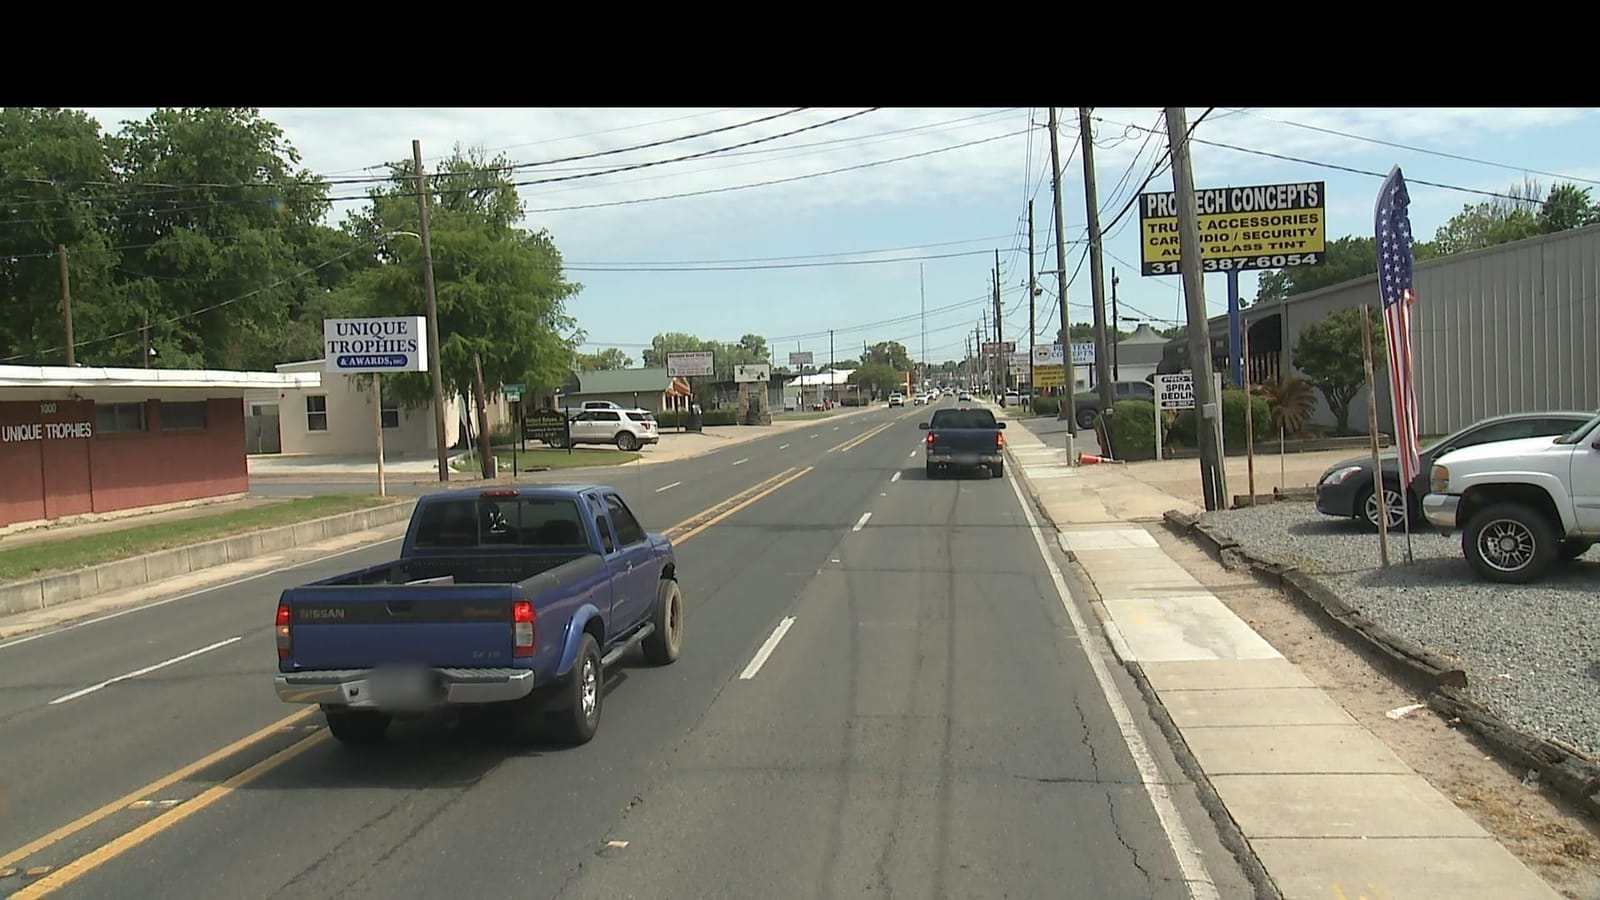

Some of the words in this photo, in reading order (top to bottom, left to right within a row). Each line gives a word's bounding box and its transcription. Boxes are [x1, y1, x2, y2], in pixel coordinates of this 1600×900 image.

[1194, 189, 1226, 215] ECH
[1231, 183, 1318, 211] CONCEPTS
[1207, 213, 1319, 230] ACCESSORIES
[1149, 237, 1178, 246] CAR
[1242, 227, 1317, 240] SECURITY
[1210, 243, 1263, 253] GLASS
[1267, 240, 1307, 249] TINT
[336, 321, 408, 340] UNIQUE
[328, 339, 417, 354] TROPHIES
[1161, 391, 1196, 401] BEDLIN
[40, 403, 57, 414] 1000
[2, 424, 42, 442] UNIQUE
[45, 422, 92, 440] TROPHIES
[300, 608, 345, 619] NISSAN
